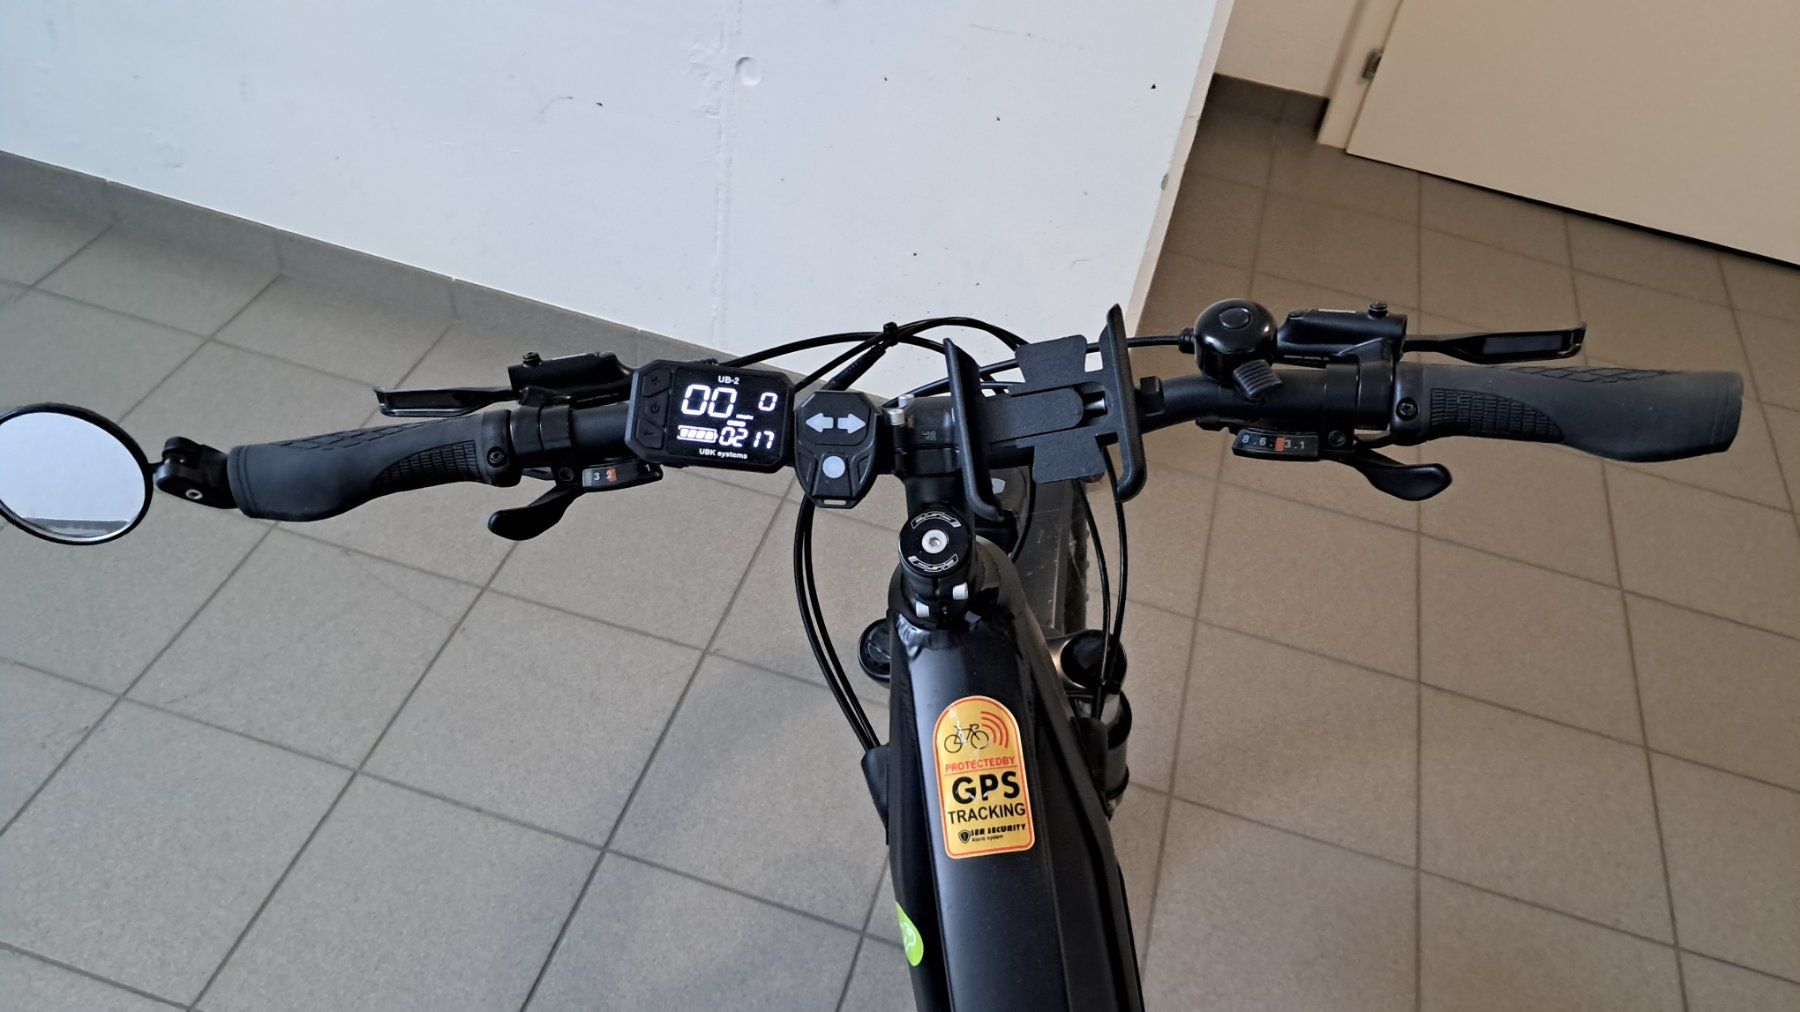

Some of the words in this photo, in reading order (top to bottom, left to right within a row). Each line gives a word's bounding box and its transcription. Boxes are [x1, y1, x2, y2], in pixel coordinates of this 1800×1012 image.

[718, 375, 740, 385] UB-2
[681, 384, 738, 418] 00
[758, 392, 778, 412] 0
[699, 448, 716, 456] UBK
[952, 771, 1020, 805] GPS
[948, 802, 1026, 825] TRACKING
[987, 823, 1026, 835] SECURITY
